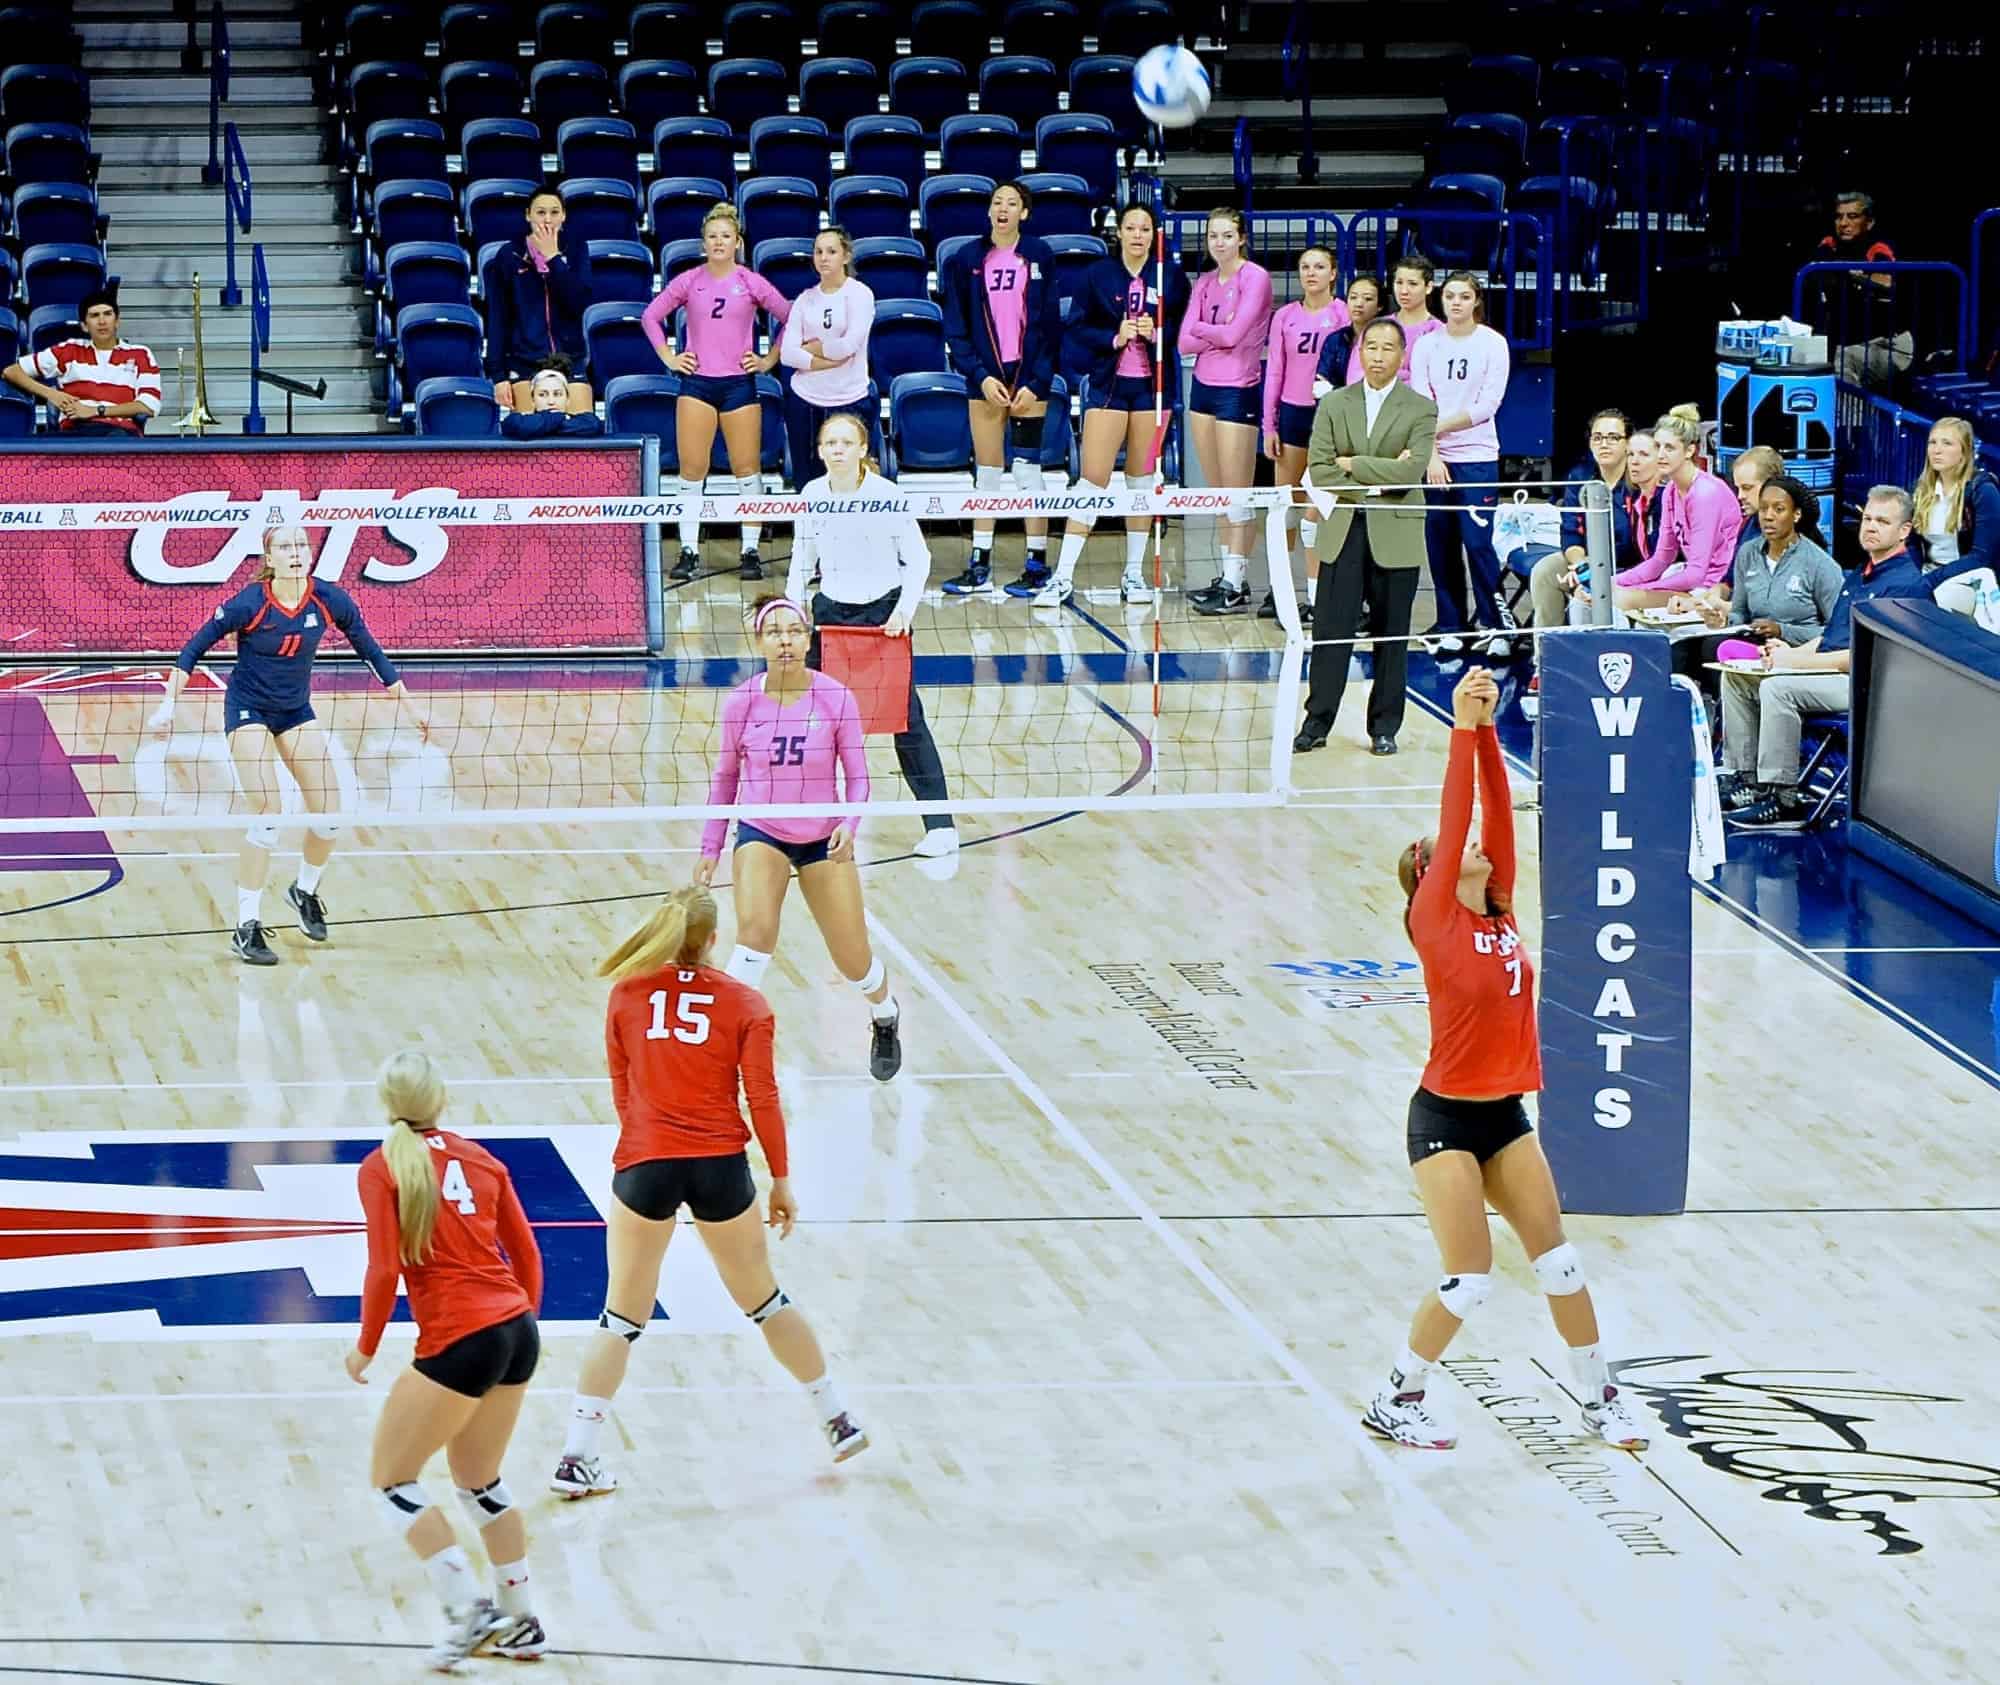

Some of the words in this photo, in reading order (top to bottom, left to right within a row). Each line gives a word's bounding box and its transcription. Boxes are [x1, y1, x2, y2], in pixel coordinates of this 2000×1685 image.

[989, 269, 1017, 291] 33
[711, 297, 726, 319] 2
[823, 308, 833, 329] 5
[1297, 332, 1320, 354] 21
[1447, 358, 1468, 380] 13
[0, 511, 43, 524] BALL
[95, 508, 251, 523] ARIZONAWILDCATS
[300, 505, 479, 521] ARIZONAVOLLEYBALL
[528, 503, 685, 518] ARIZONAWILDCATS
[735, 499, 911, 514] ARIZONAVOLLEYBALL
[960, 496, 1116, 512] ARIZONAWILDCATS
[130, 486, 459, 584] CATS
[277, 633, 303, 657] 11
[769, 735, 807, 766] 35
[1591, 696, 1643, 1130] WILDCATS
[1504, 959, 1522, 997] 7
[646, 988, 715, 1046] 15
[441, 1158, 478, 1215] 4
